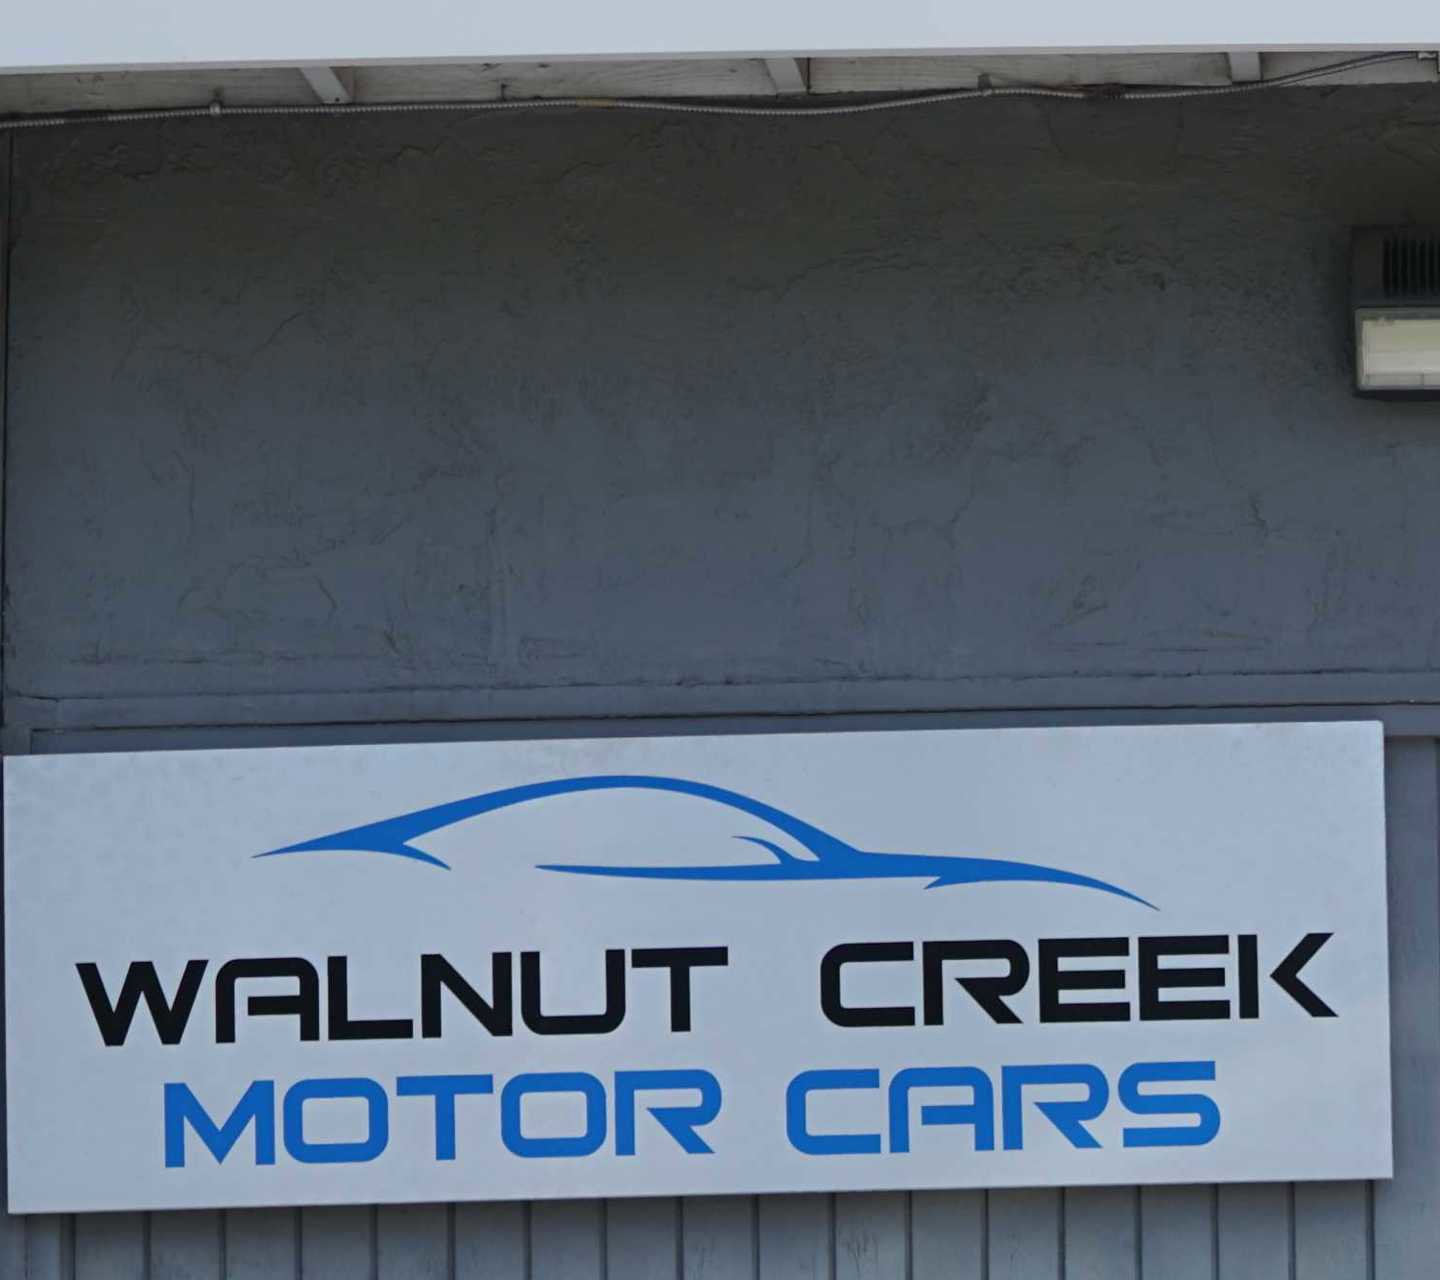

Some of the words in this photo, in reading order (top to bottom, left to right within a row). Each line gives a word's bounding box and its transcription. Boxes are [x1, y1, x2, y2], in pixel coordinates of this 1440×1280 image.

[75, 946, 729, 1047] WALNUT
[820, 932, 1338, 1028] CREEK
[163, 1070, 722, 1168] MOTOR
[786, 1060, 1221, 1156] CARS
